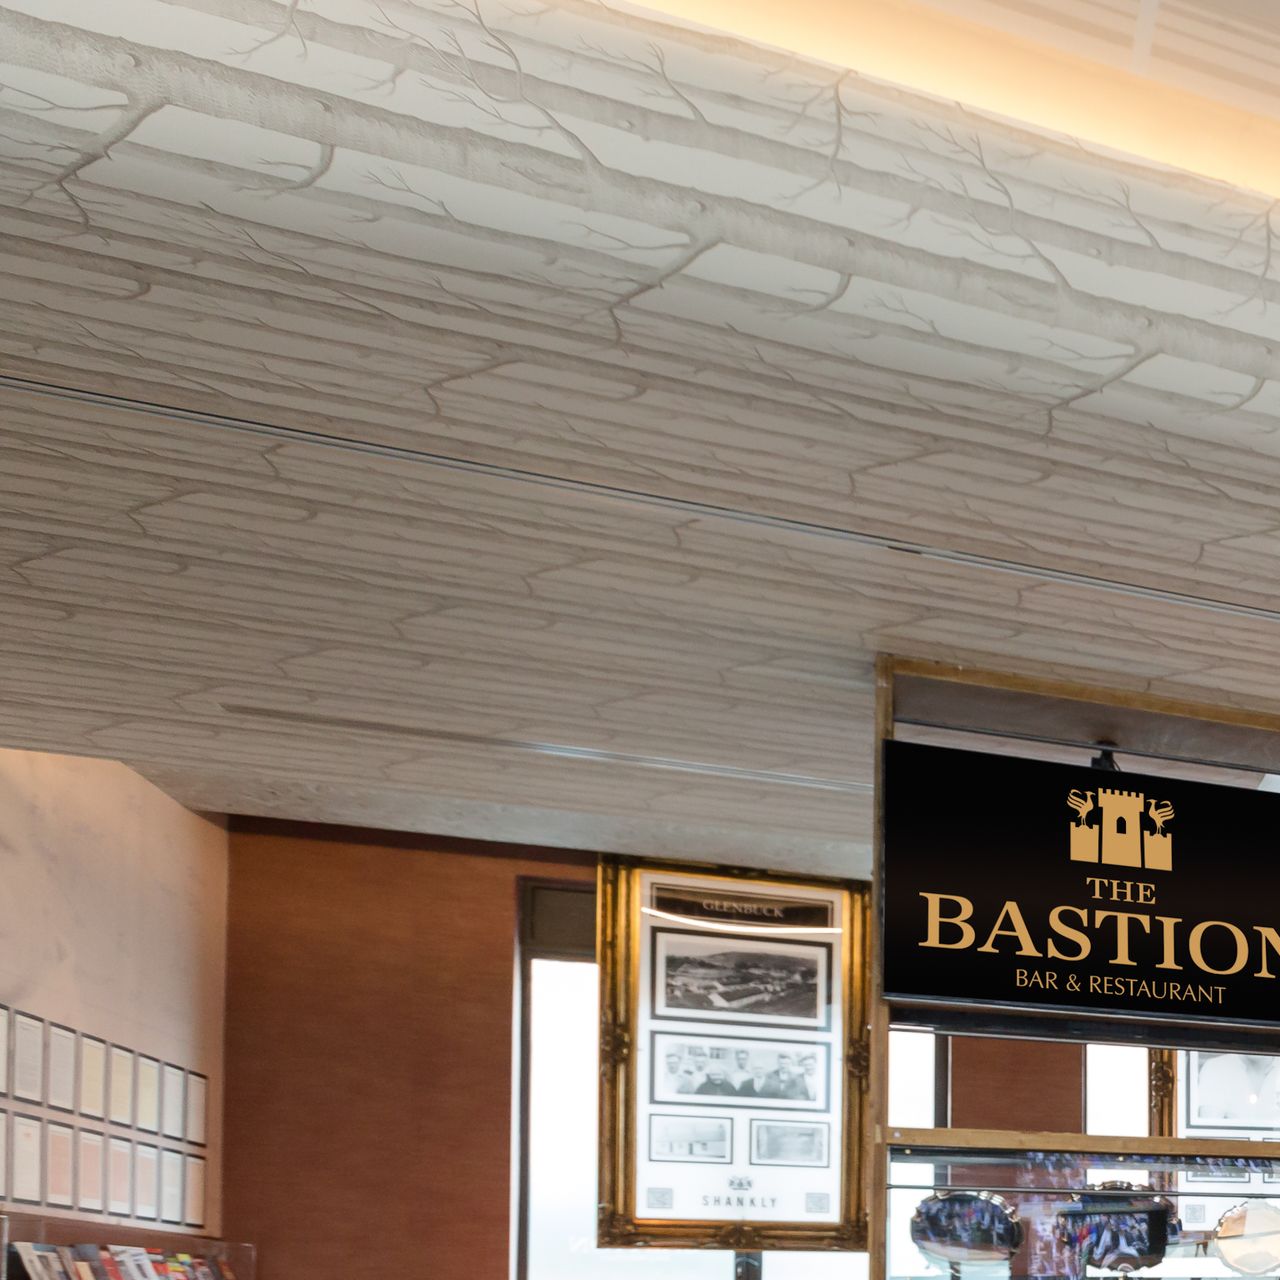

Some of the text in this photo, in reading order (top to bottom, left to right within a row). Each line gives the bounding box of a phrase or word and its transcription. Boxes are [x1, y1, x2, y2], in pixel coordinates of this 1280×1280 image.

[1086, 877, 1157, 905] THE
[702, 900, 785, 918] GLENBUCK
[1015, 969, 1227, 1004] BAR & RESTAURANT
[702, 1195, 777, 1208] SHANKLY
